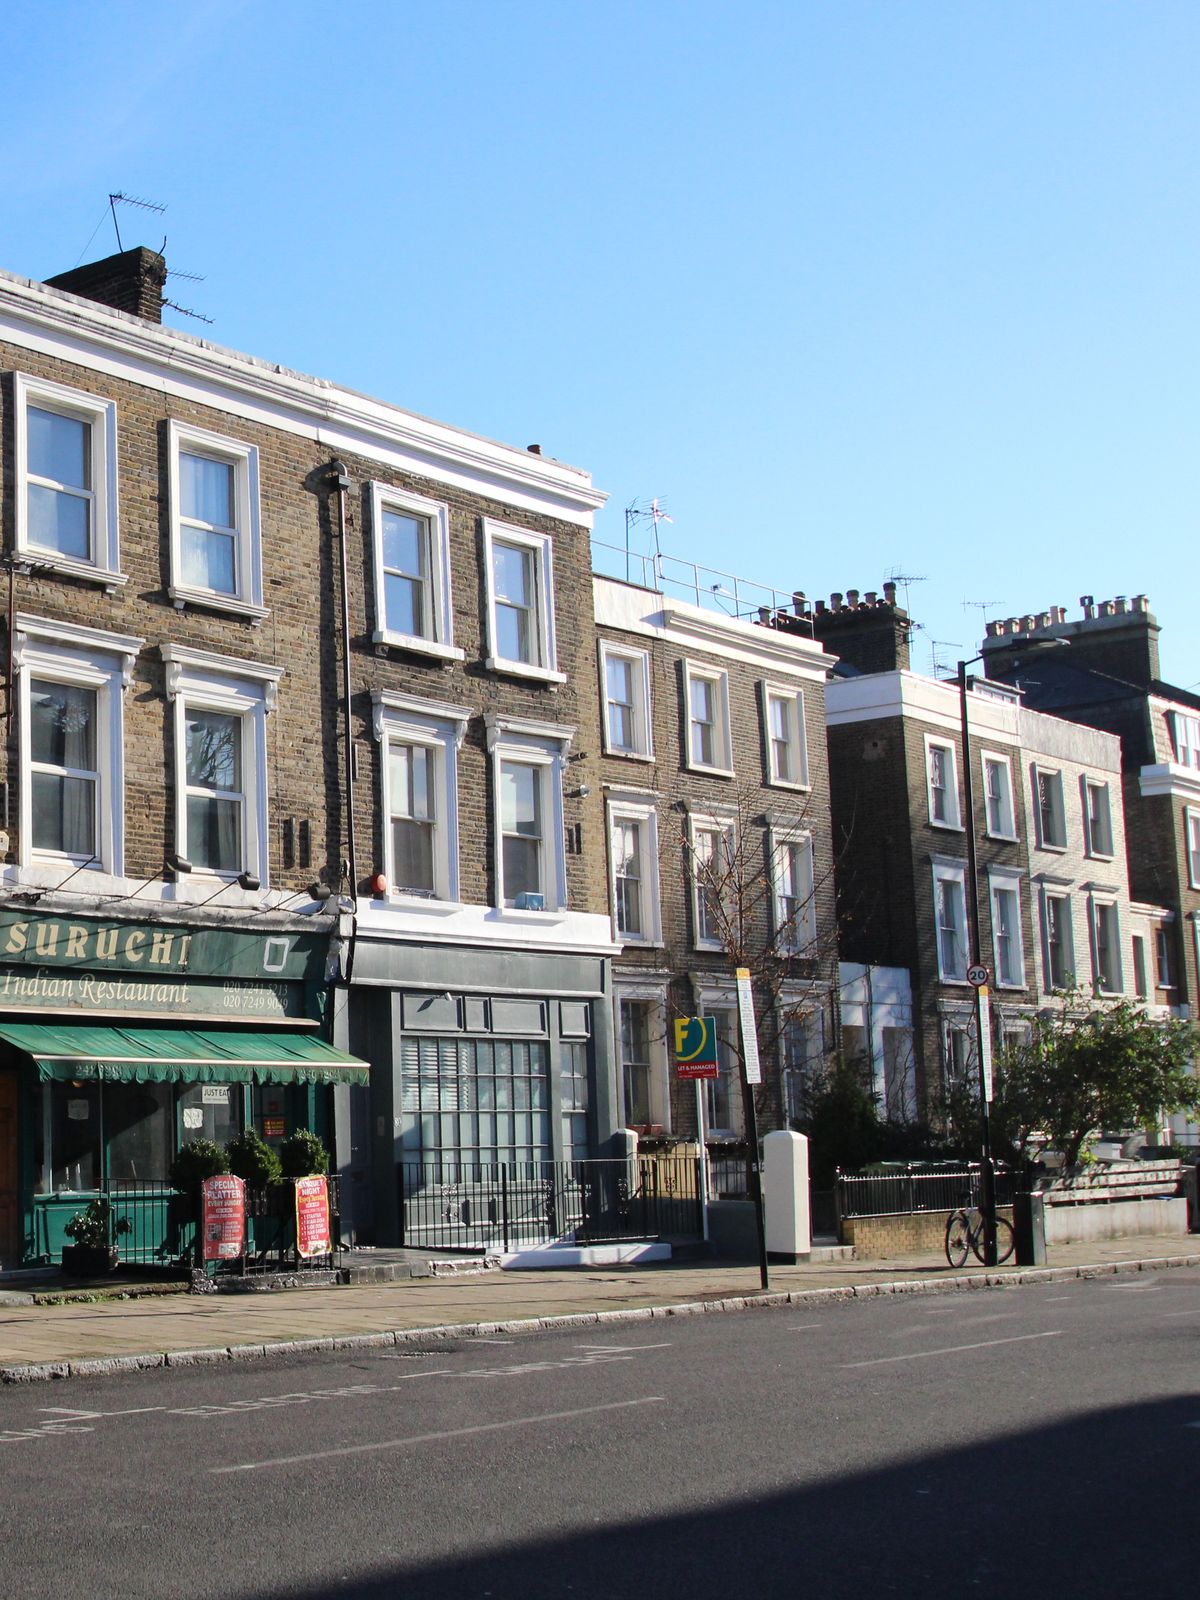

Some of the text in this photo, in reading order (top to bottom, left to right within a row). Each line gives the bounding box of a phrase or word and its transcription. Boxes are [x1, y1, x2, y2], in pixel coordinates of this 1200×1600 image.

[4, 921, 192, 966] SURUCHI
[969, 970, 986, 981] 20
[1, 969, 190, 1004] Indian Restaurant
[223, 980, 241, 993] 020
[223, 995, 241, 1008] 020
[243, 996, 265, 1009] 7249
[204, 1088, 218, 1097] JUST
[209, 1180, 239, 1190] SPECIAL
[207, 1190, 241, 1200] PLATTER
[301, 1186, 321, 1197] NIGHT
[168, 1384, 402, 1416] ELECTRIC
